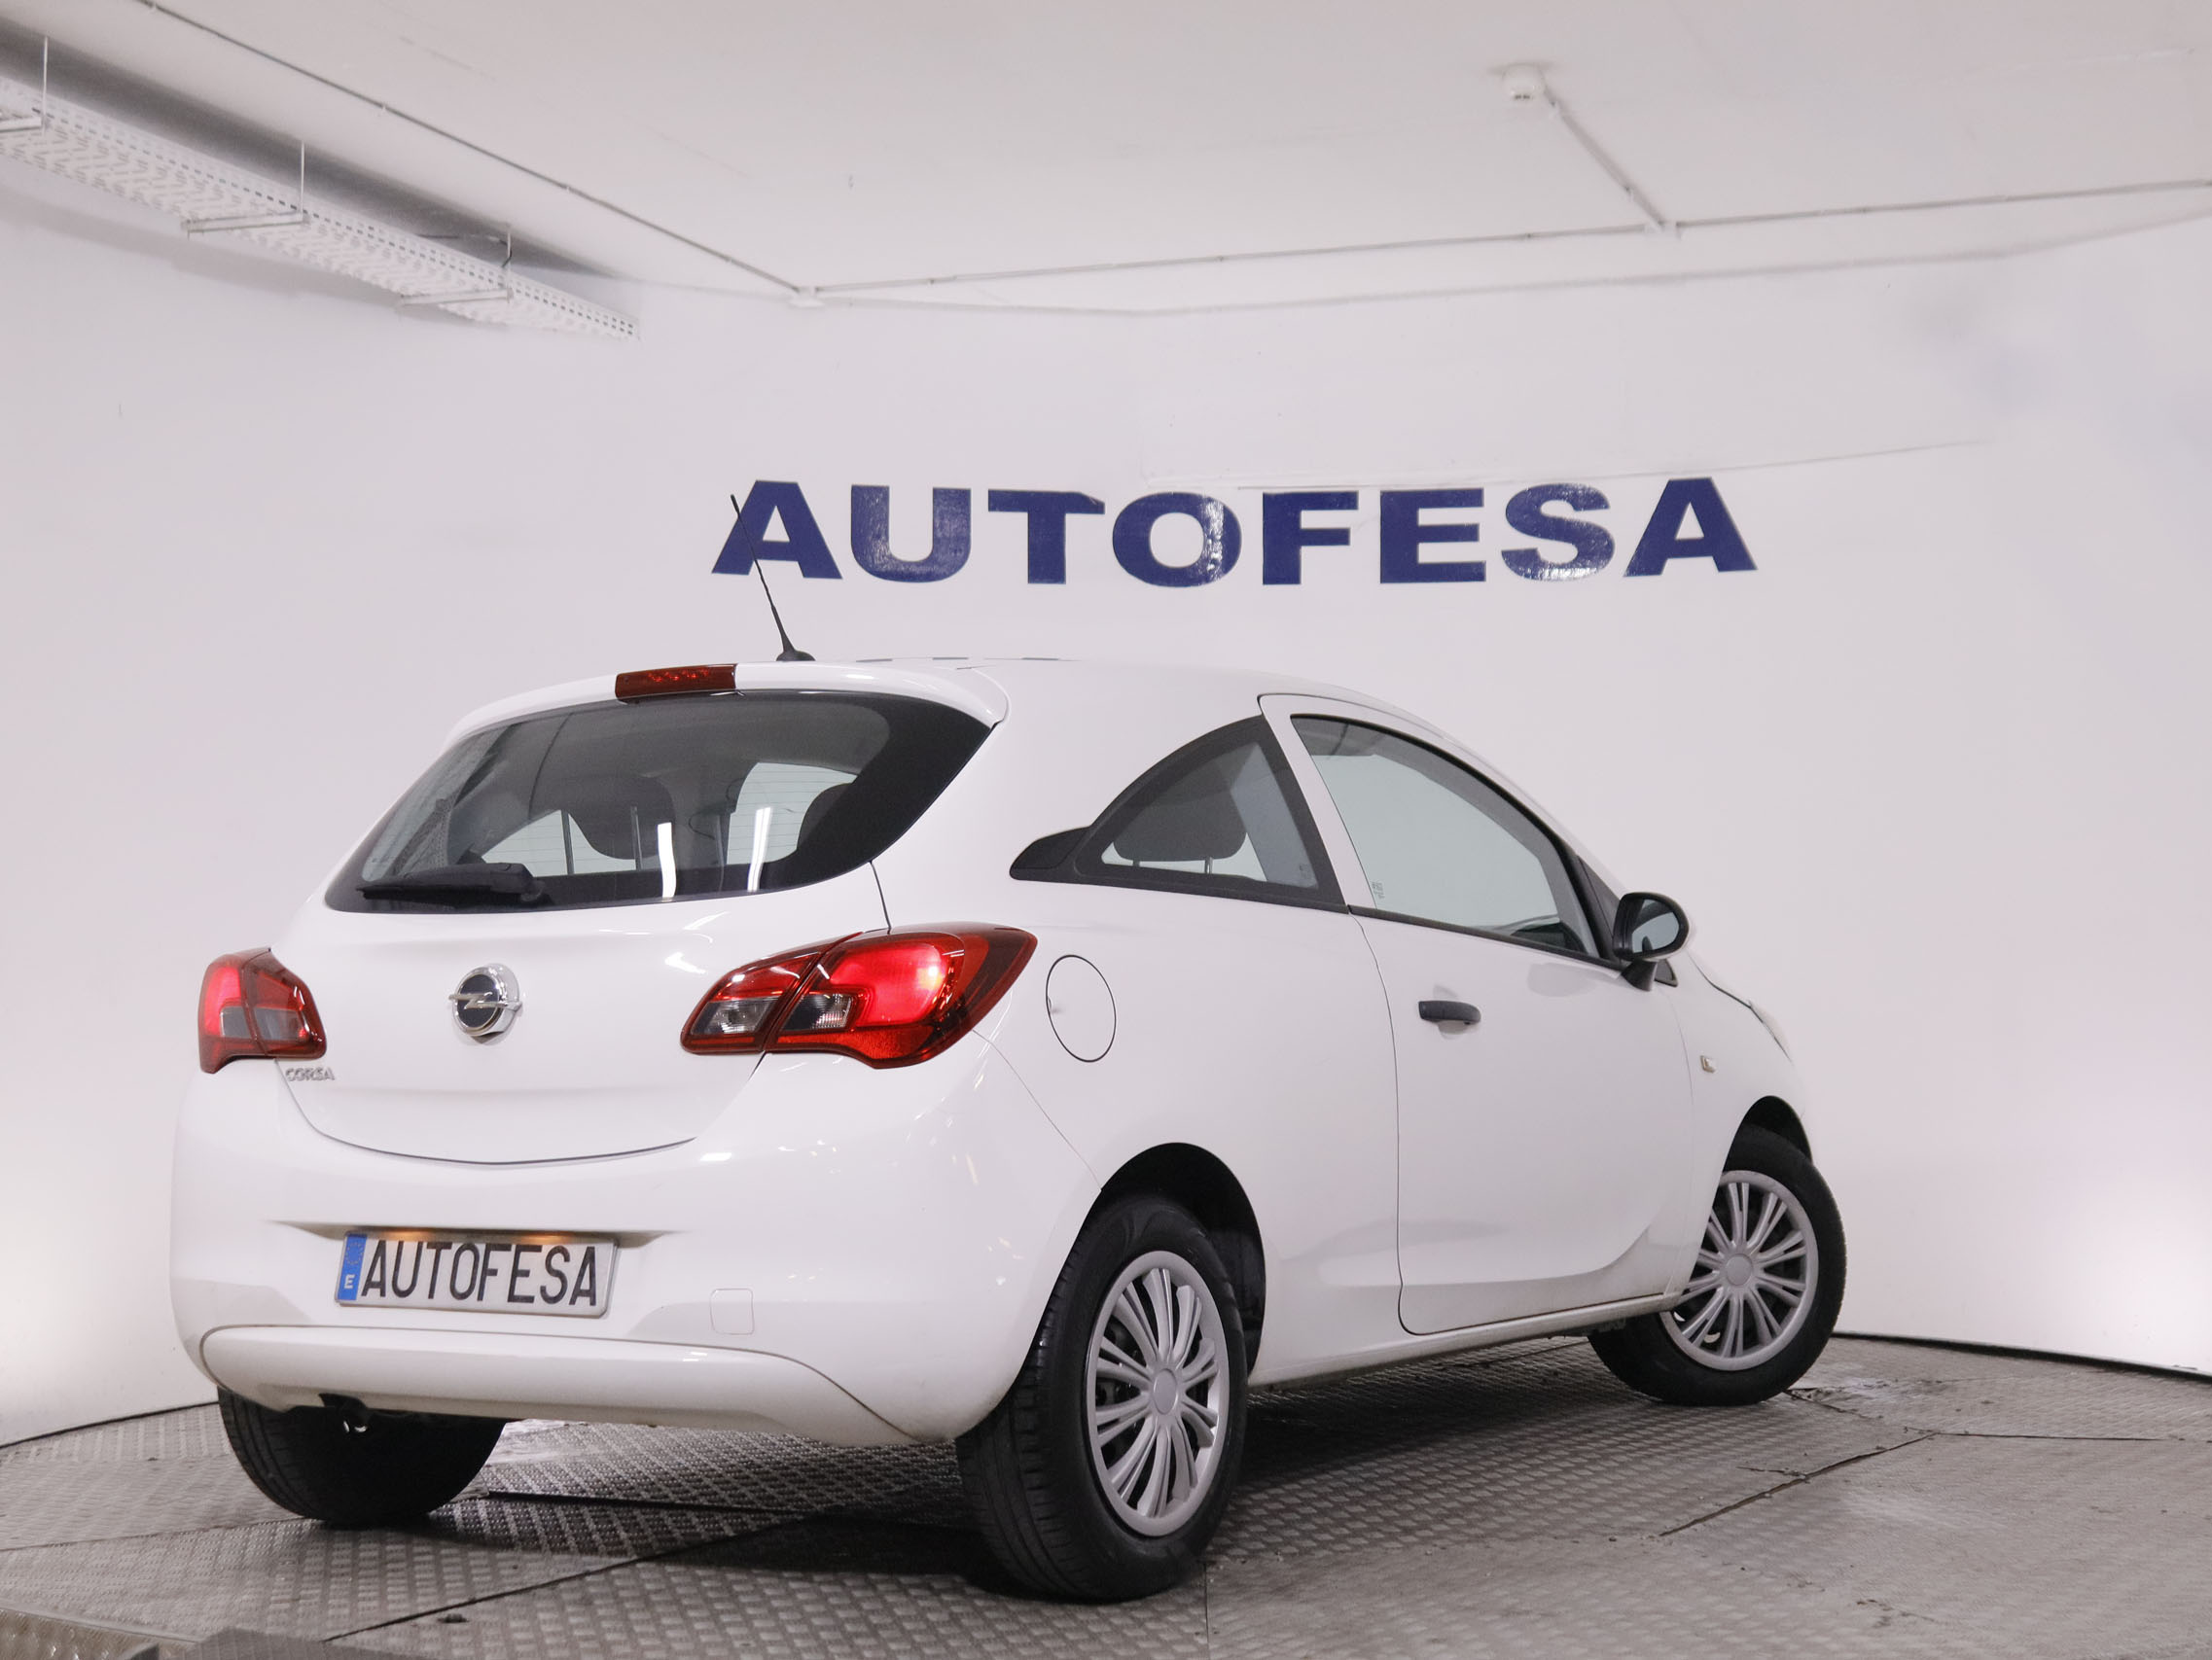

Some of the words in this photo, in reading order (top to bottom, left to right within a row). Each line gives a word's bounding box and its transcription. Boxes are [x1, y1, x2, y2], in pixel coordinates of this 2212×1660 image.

[711, 477, 1758, 588] AUTOFESA
[285, 1067, 336, 1081] CORSA
[343, 1274, 355, 1289] E
[361, 1239, 597, 1306] AUTOFESA
